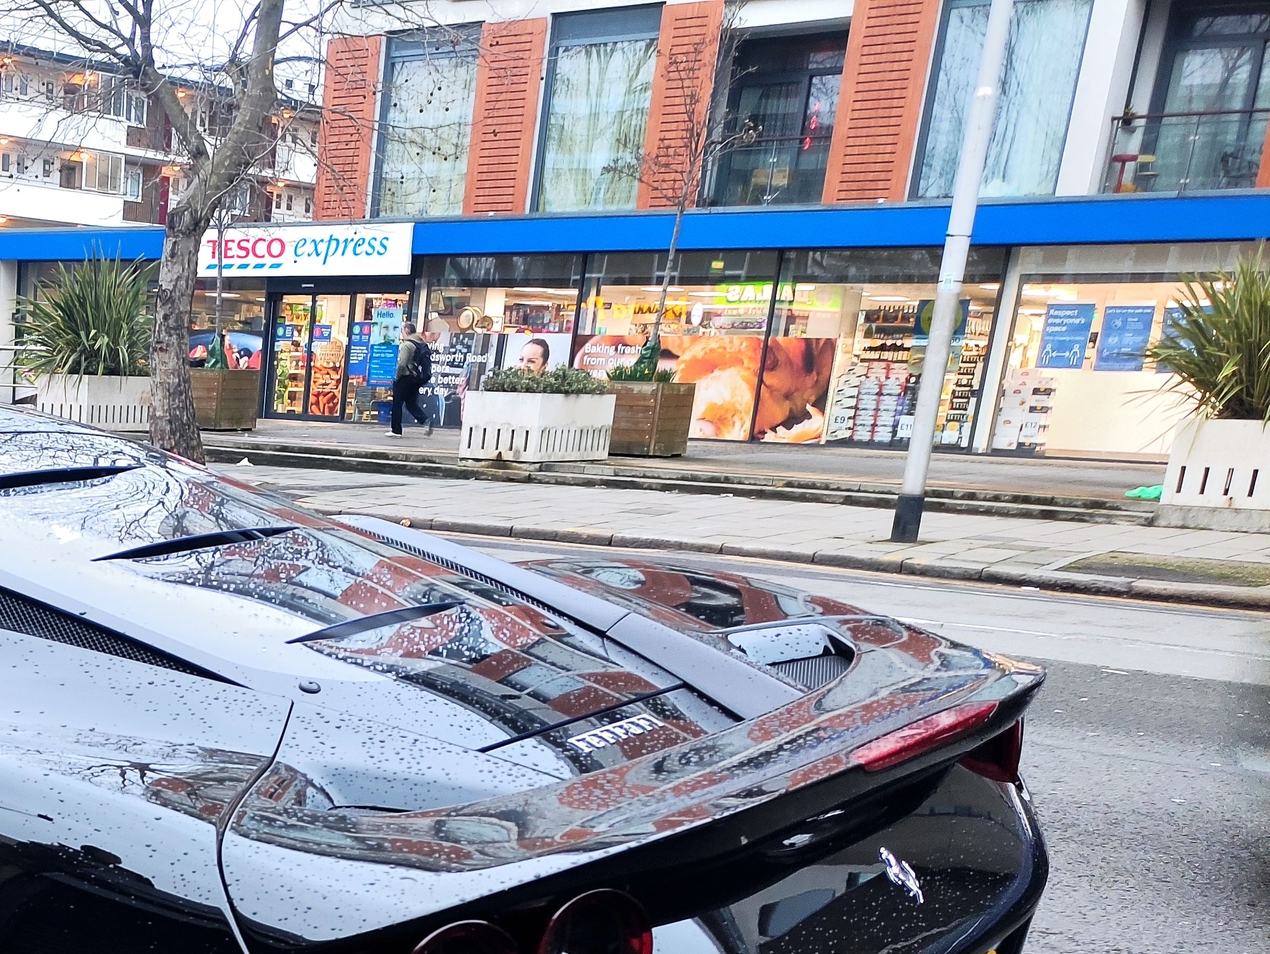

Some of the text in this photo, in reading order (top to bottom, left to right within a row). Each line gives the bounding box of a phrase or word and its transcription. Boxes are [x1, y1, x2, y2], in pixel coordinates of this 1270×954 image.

[206, 233, 390, 265] TESCO express
[376, 310, 396, 319] Hello.
[1049, 309, 1079, 317] Respect
[584, 343, 642, 355] Baking fresh
[430, 352, 493, 362] dsworth Road's
[583, 354, 606, 365] from
[608, 357, 624, 366] our
[437, 374, 466, 385] better
[433, 386, 449, 397] day
[567, 713, 665, 754] Ferrari
